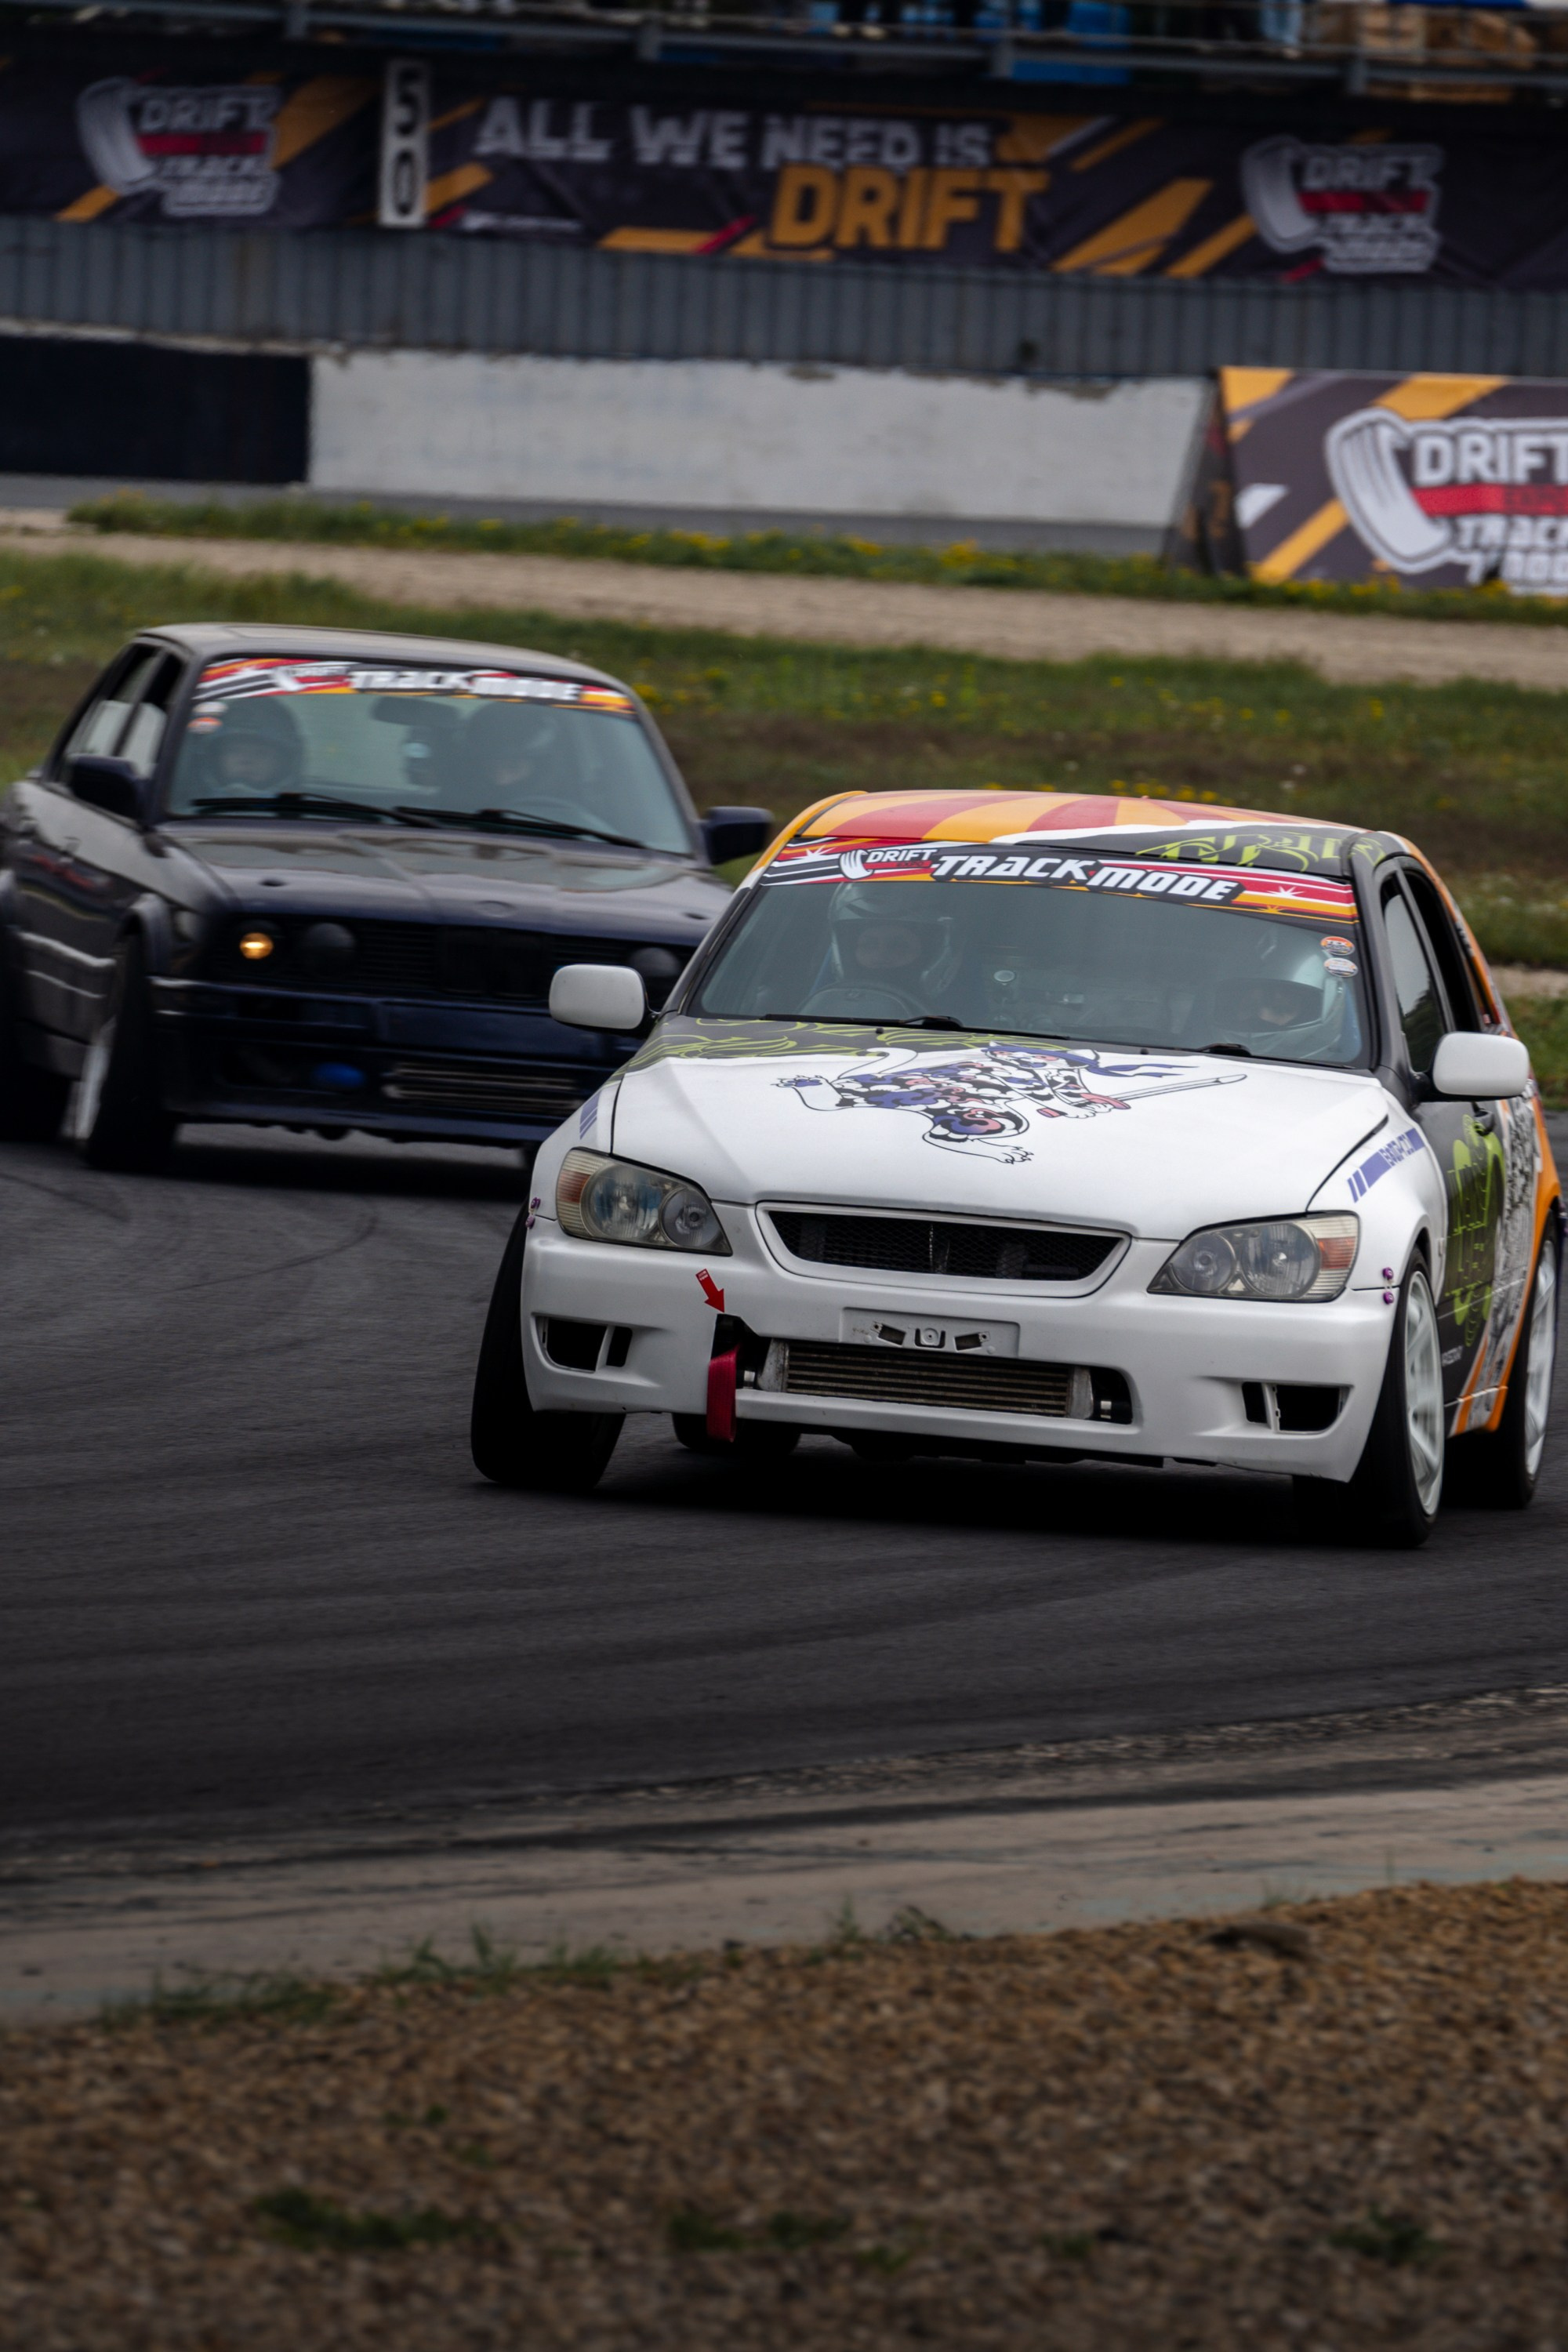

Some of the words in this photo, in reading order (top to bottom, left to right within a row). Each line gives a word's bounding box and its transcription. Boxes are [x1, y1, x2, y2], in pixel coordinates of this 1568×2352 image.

[140, 96, 271, 131] DRIFT
[476, 96, 617, 158] ALL
[632, 106, 750, 169] WE
[762, 114, 922, 170] NEED
[937, 122, 993, 167] IS
[768, 165, 1050, 252] DRIFT
[866, 849, 938, 863] DRIFT
[932, 855, 1097, 880] TRACK
[1087, 866, 1240, 901] MODE
